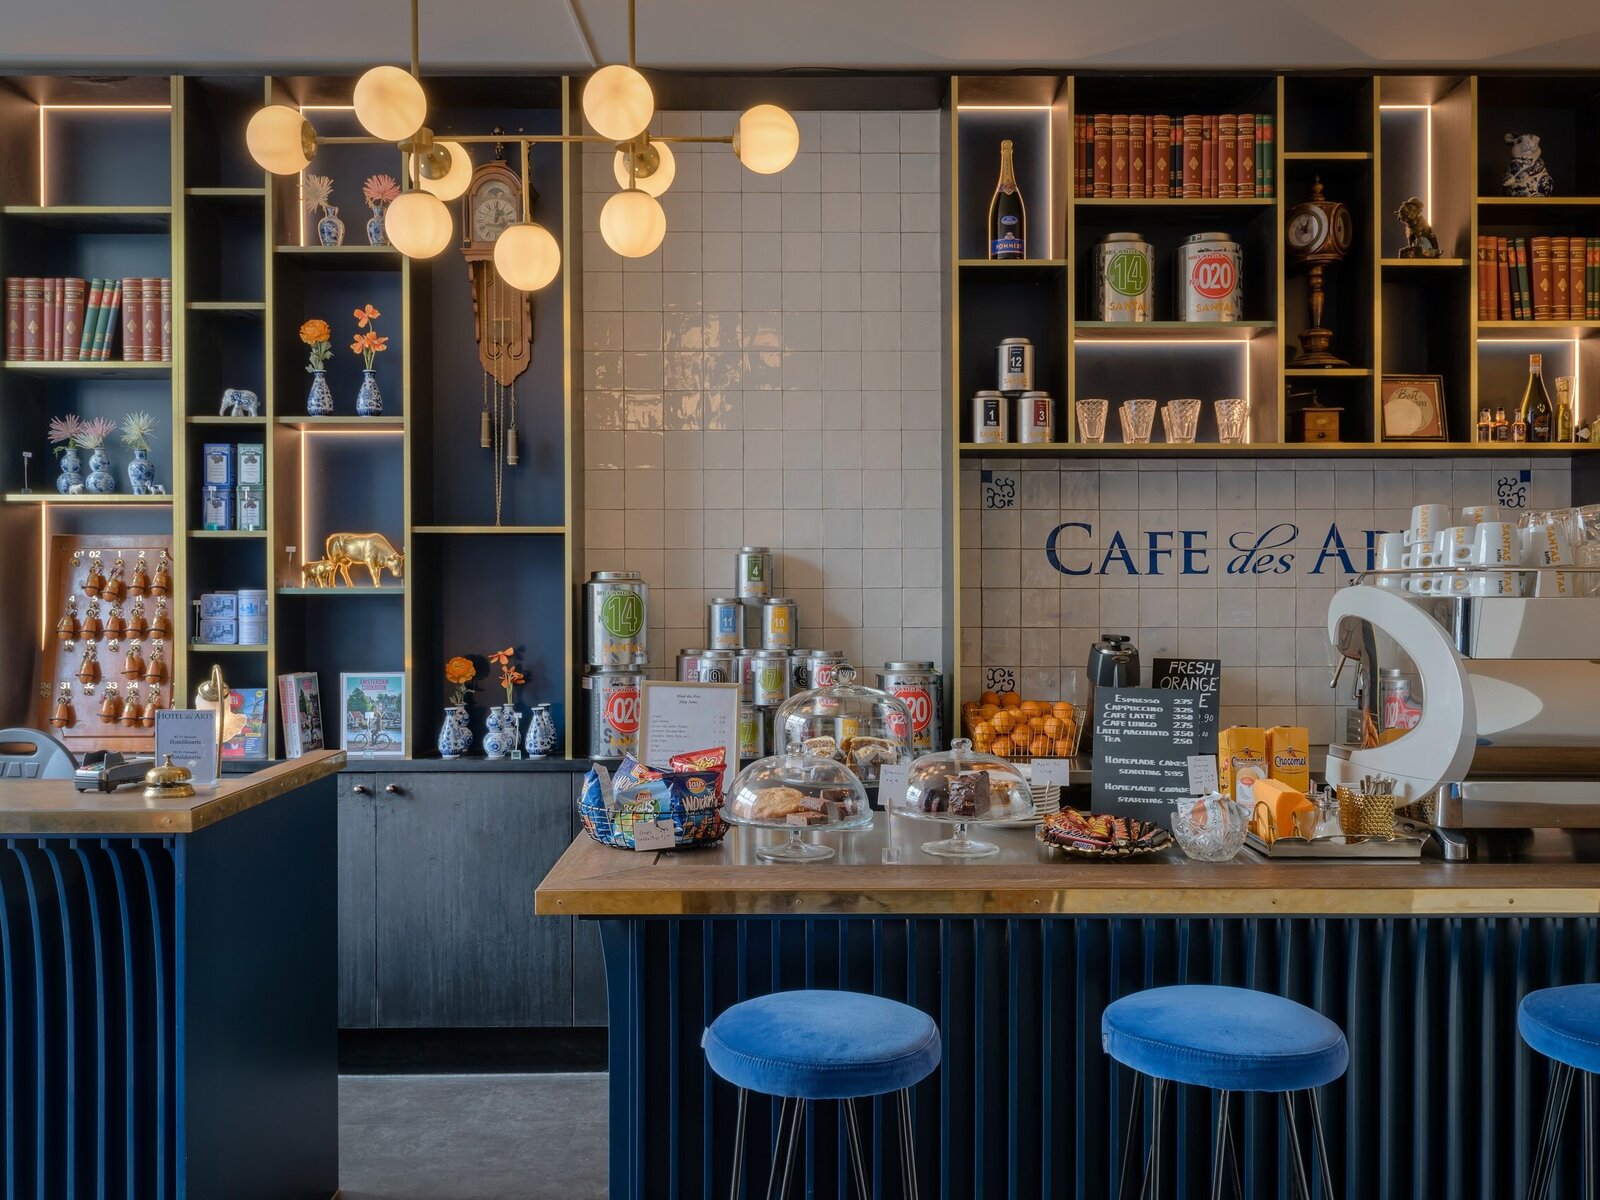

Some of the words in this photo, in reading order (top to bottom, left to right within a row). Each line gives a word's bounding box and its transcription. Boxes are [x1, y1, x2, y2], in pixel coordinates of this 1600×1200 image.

[1115, 255, 1143, 290] 14
[1199, 263, 1232, 289] 020
[1011, 357, 1022, 367] 12
[989, 410, 994, 421] 1
[1039, 411, 1045, 421] 3
[1046, 522, 1210, 575] CAFE
[1227, 522, 1300, 575] des
[1503, 524, 1512, 562] SANTAS
[1546, 525, 1560, 563] SANTAS
[753, 566, 759, 576] 4
[608, 596, 638, 632] 14
[722, 617, 733, 627] 11
[774, 618, 785, 627] 10
[688, 669, 698, 679] 25
[1169, 661, 1215, 676] FRESH
[767, 670, 776, 690] 7
[1160, 676, 1219, 692] ORANGE
[158, 712, 183, 720] HOTEL
[194, 712, 214, 720] ARTS
[745, 723, 752, 743] 7
[1096, 726, 1120, 735] LATTE
[1103, 735, 1121, 743] TEA
[1104, 756, 1156, 766] HOMEMADE
[1159, 759, 1188, 767] CAKES
[1274, 755, 1306, 767] Chocomel
[1118, 768, 1161, 776] STARTING
[1104, 783, 1156, 792] HOMEMADE
[1118, 796, 1163, 804] STARTING
